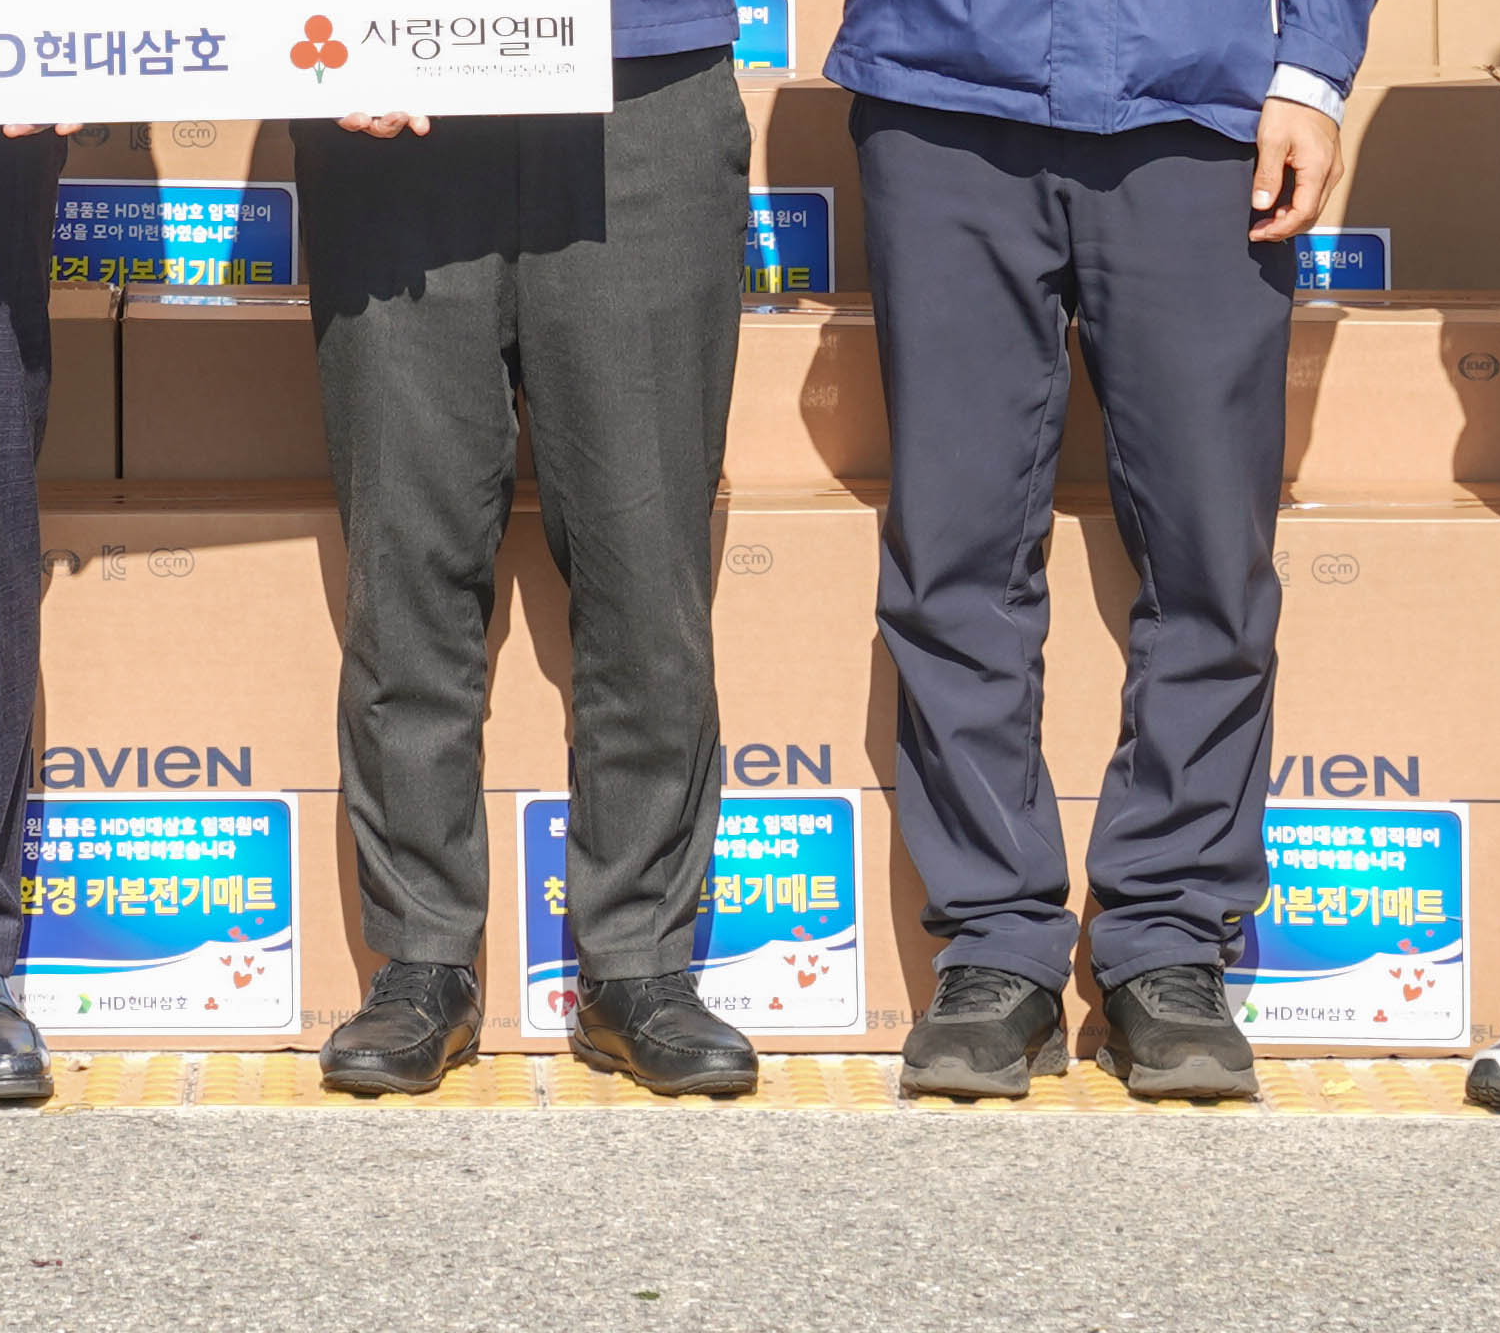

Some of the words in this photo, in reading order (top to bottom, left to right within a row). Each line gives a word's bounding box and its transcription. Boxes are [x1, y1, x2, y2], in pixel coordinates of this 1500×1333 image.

[361, 16, 574, 60] 사랑의열매
[63, 201, 109, 220] 물품은
[114, 202, 202, 221] HD현대삼호
[207, 203, 270, 222] 임직원이
[91, 224, 123, 241] 모아
[127, 224, 238, 243] 마련하였습니다
